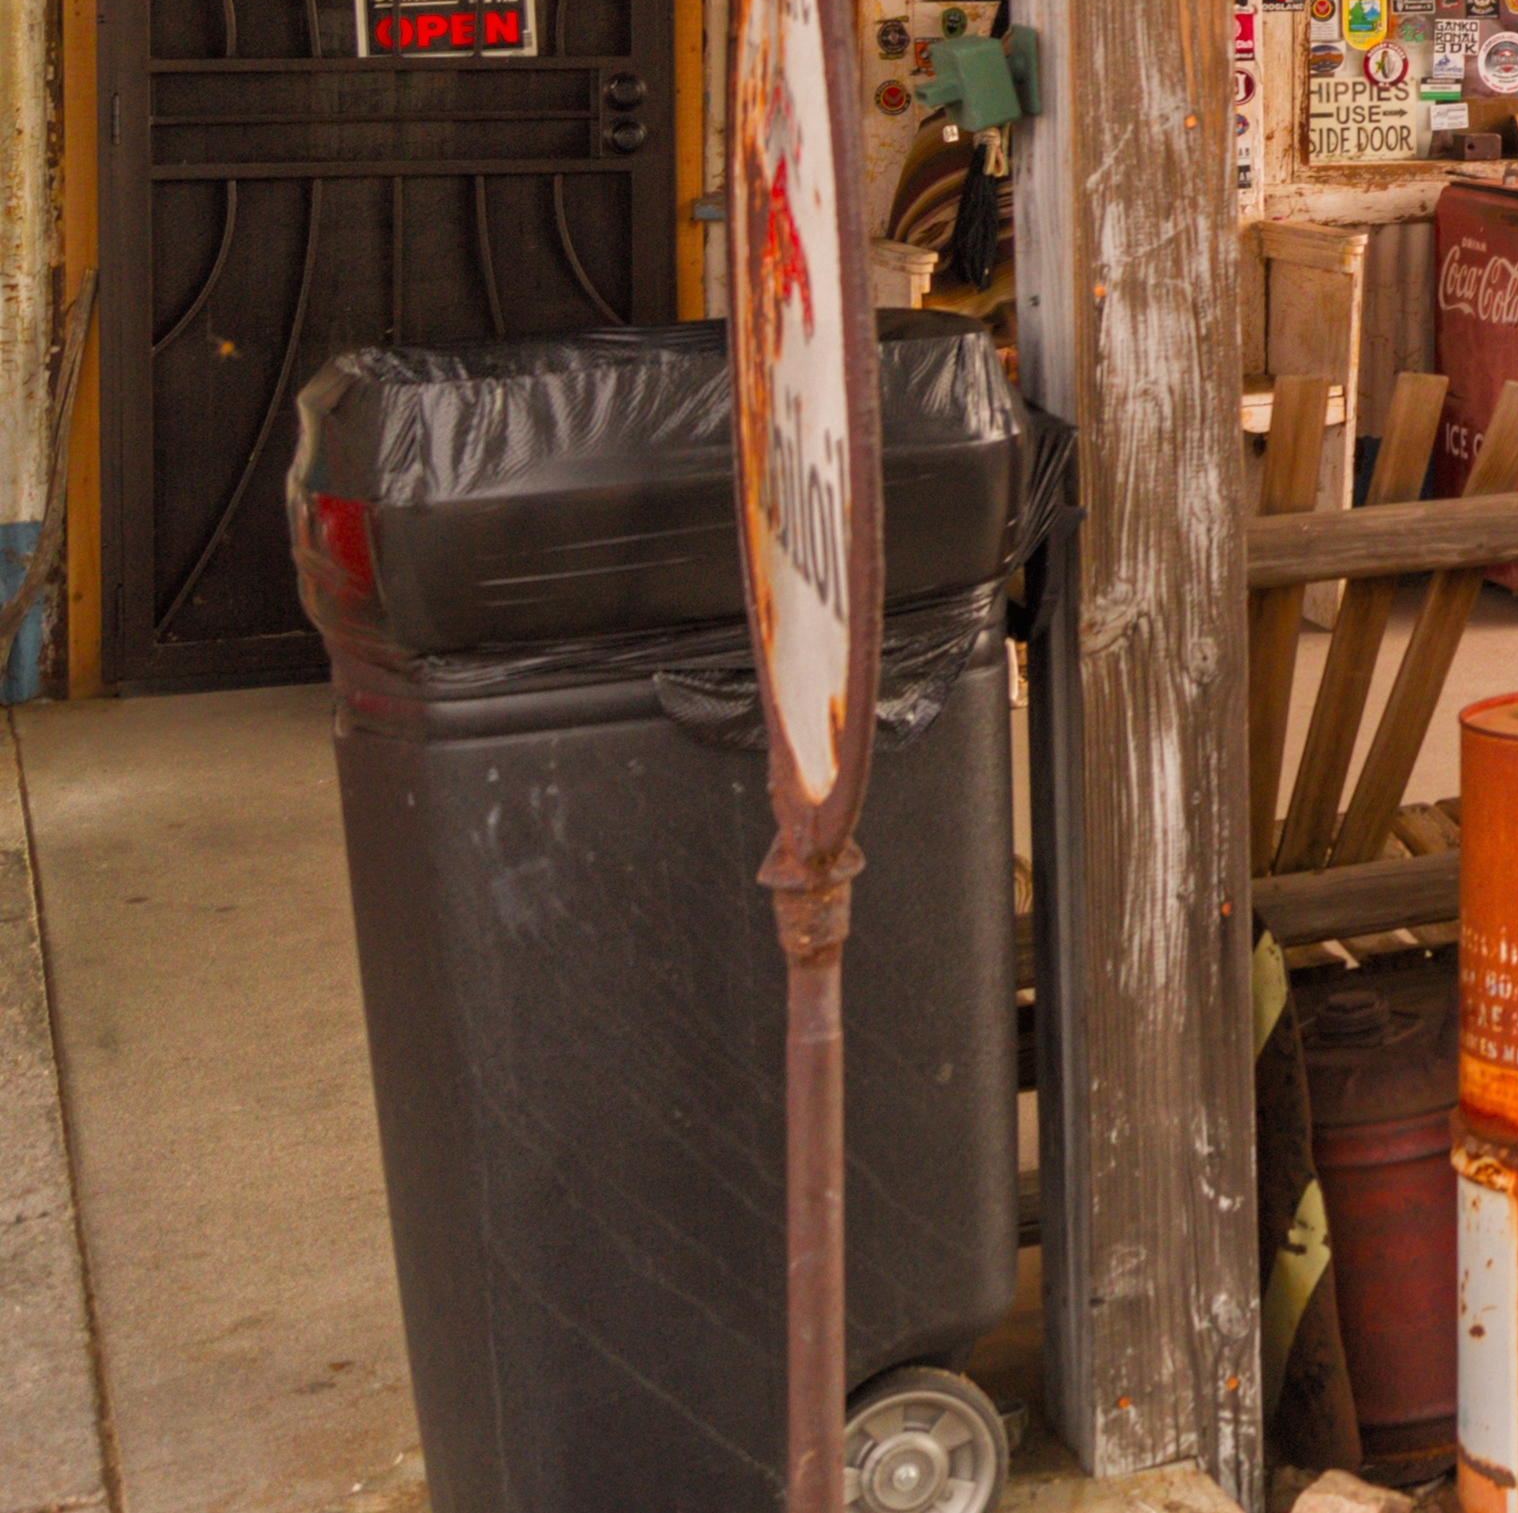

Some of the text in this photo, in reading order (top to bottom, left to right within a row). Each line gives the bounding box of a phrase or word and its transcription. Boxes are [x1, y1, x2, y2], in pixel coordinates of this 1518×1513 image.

[375, 10, 519, 49] OPEN
[1435, 21, 1478, 32] GANKO
[1435, 43, 1477, 54] 3DK
[1310, 80, 1410, 102] HIPPIES
[1336, 105, 1381, 124] USE
[1357, 125, 1413, 152] DOOR
[1444, 422, 1469, 460] ICE
